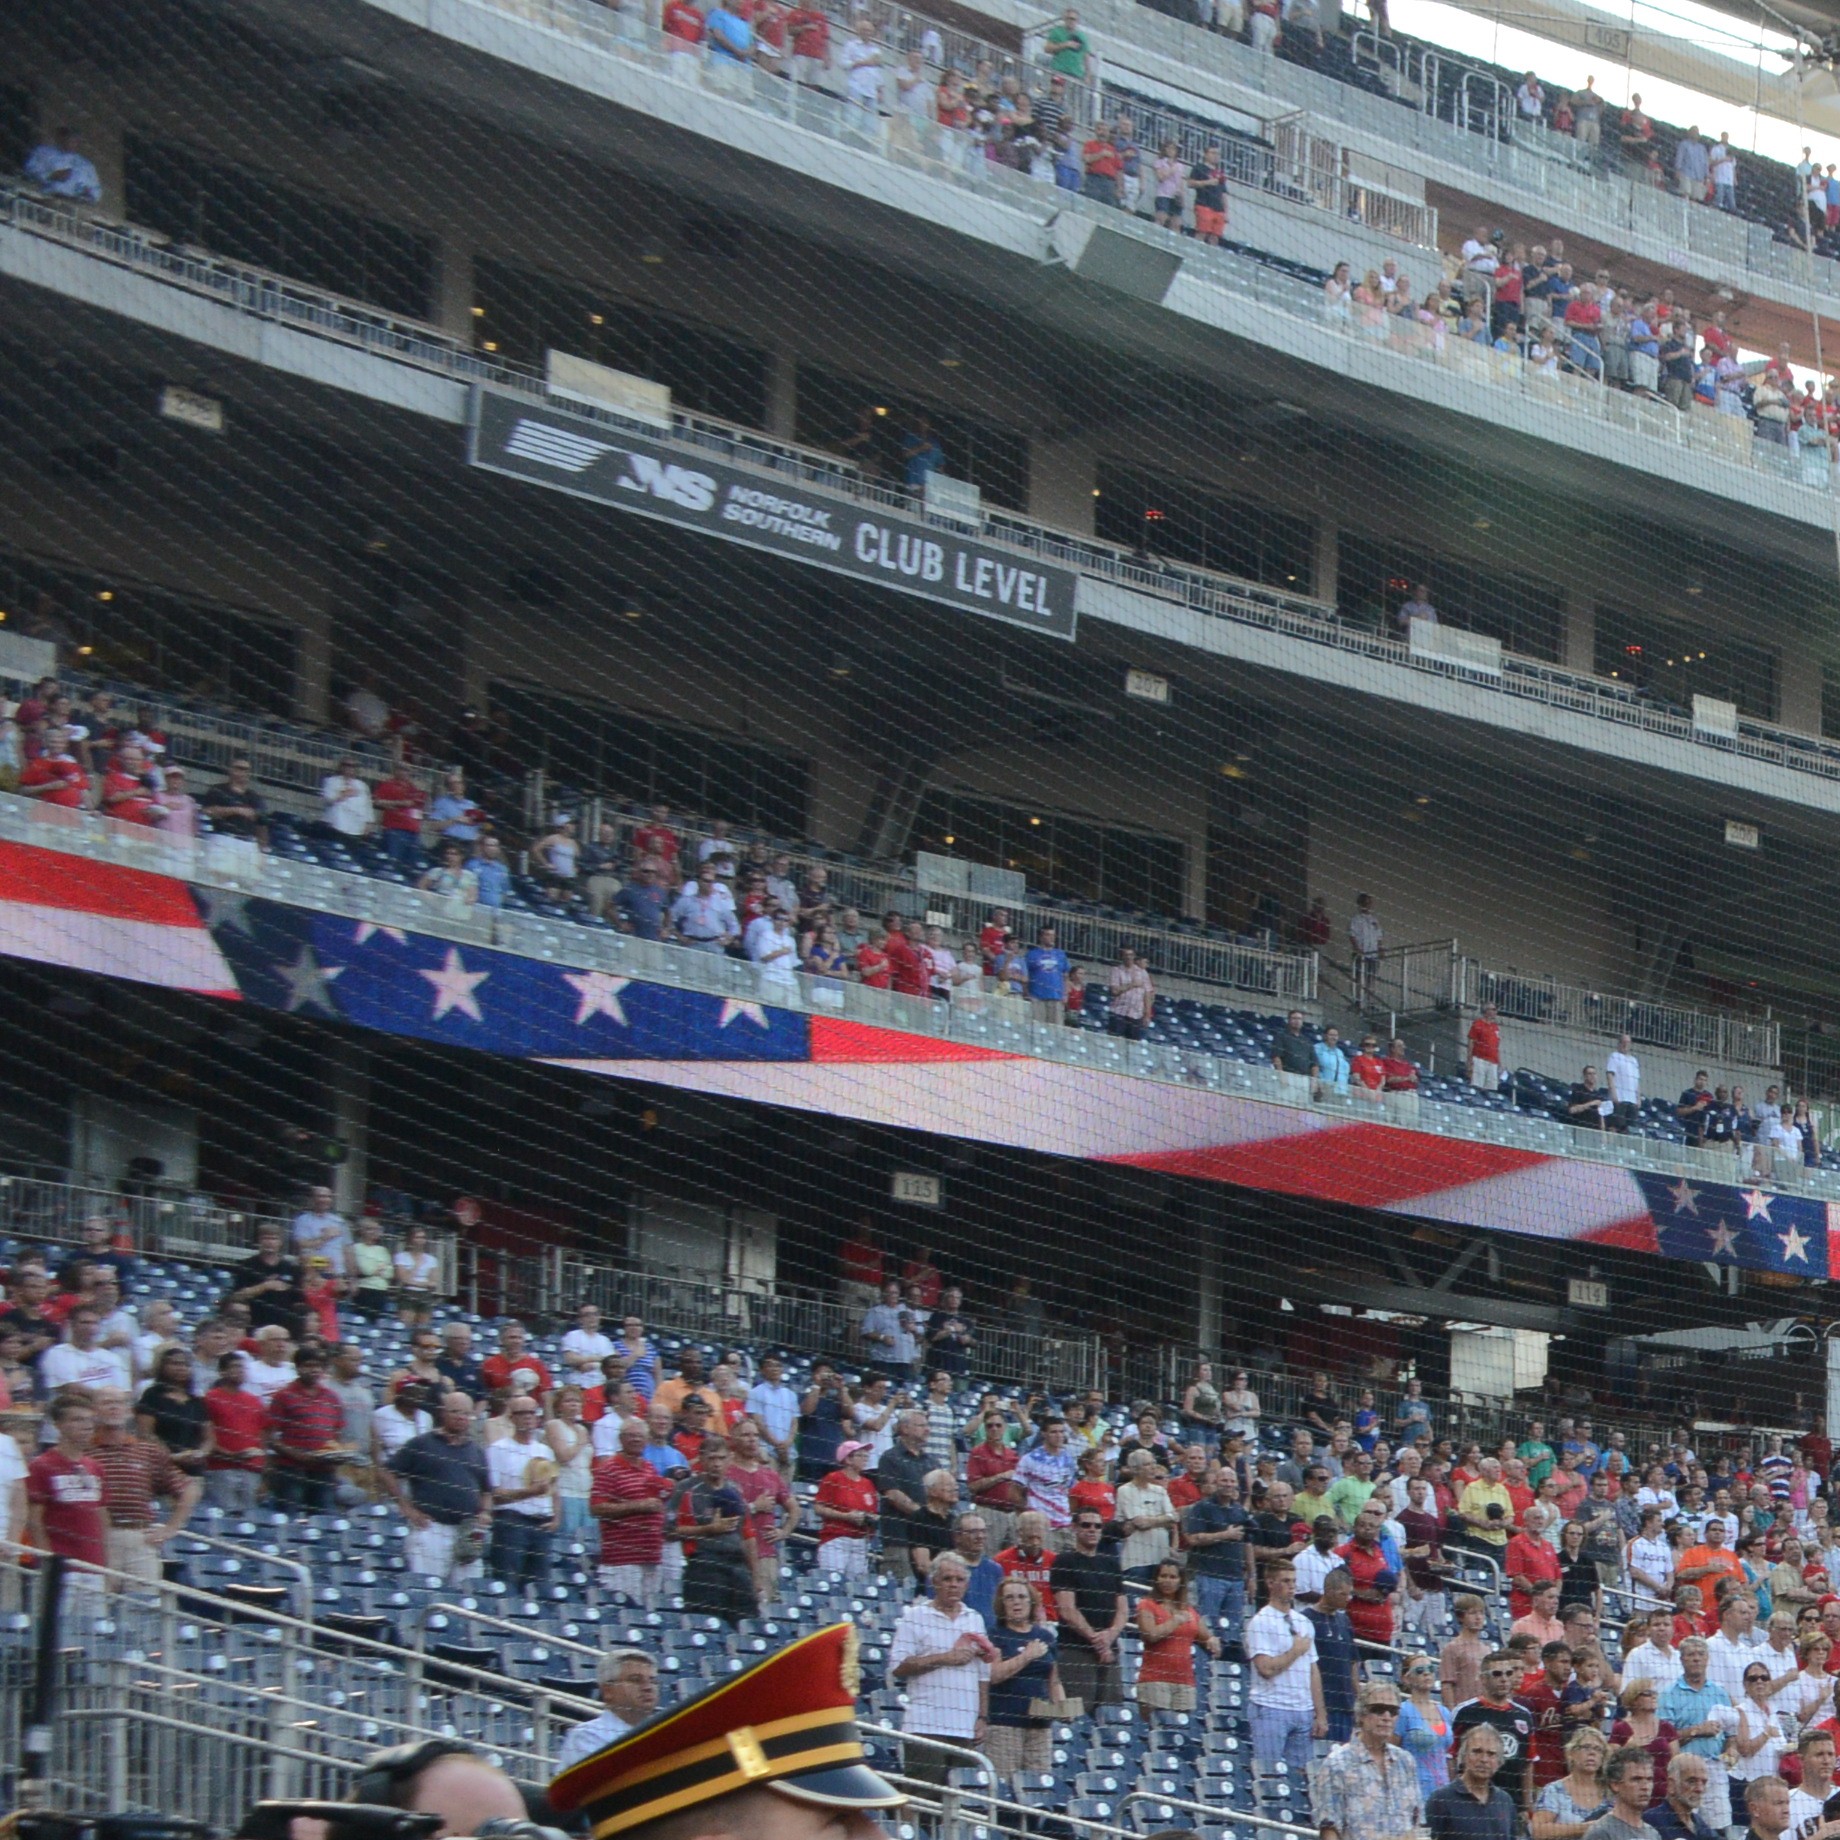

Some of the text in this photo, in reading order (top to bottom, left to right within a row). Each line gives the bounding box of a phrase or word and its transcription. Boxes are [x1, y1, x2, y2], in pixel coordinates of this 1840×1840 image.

[722, 502, 842, 552] SOUTHERN
[728, 483, 831, 530] NORFOLK
[855, 522, 1053, 618] CLUB LEVEL
[903, 1177, 932, 1199] 115
[1577, 1284, 1601, 1303] 114
